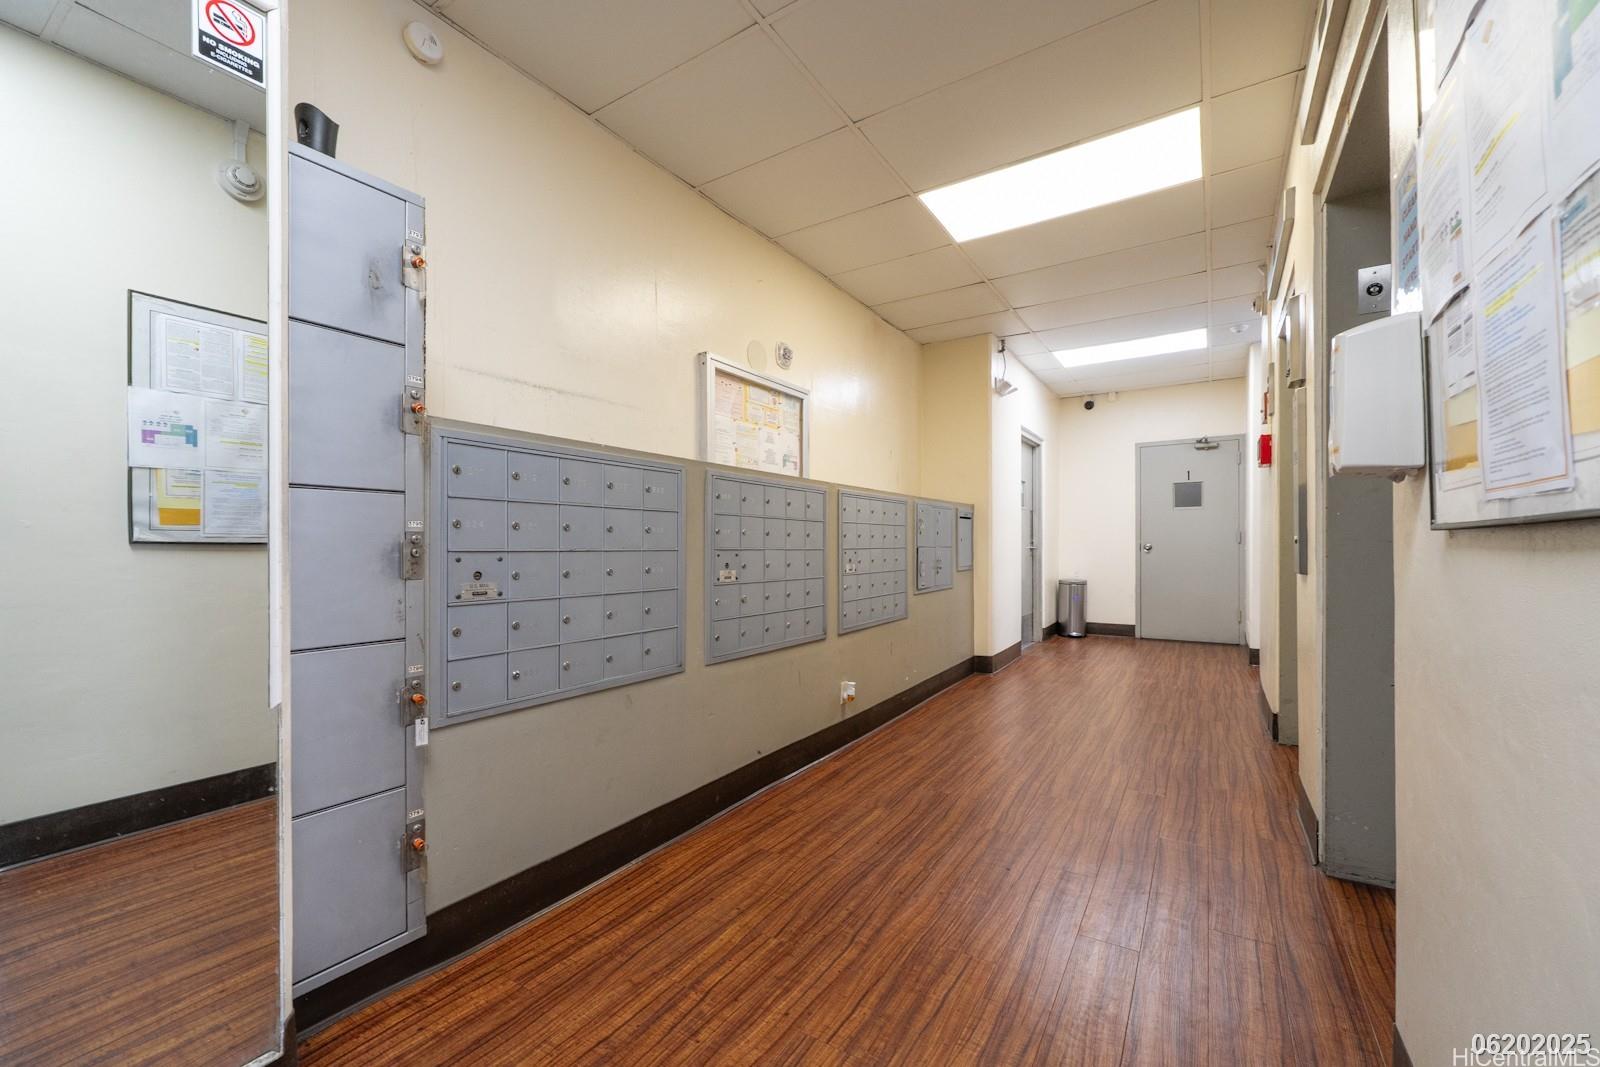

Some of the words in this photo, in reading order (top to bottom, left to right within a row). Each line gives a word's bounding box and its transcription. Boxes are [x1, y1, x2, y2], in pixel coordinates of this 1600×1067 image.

[202, 35, 217, 47] NO
[218, 43, 261, 69] SMOKING
[210, 51, 254, 76] E-CIGARETTES
[215, 48, 248, 68] INCLUDING
